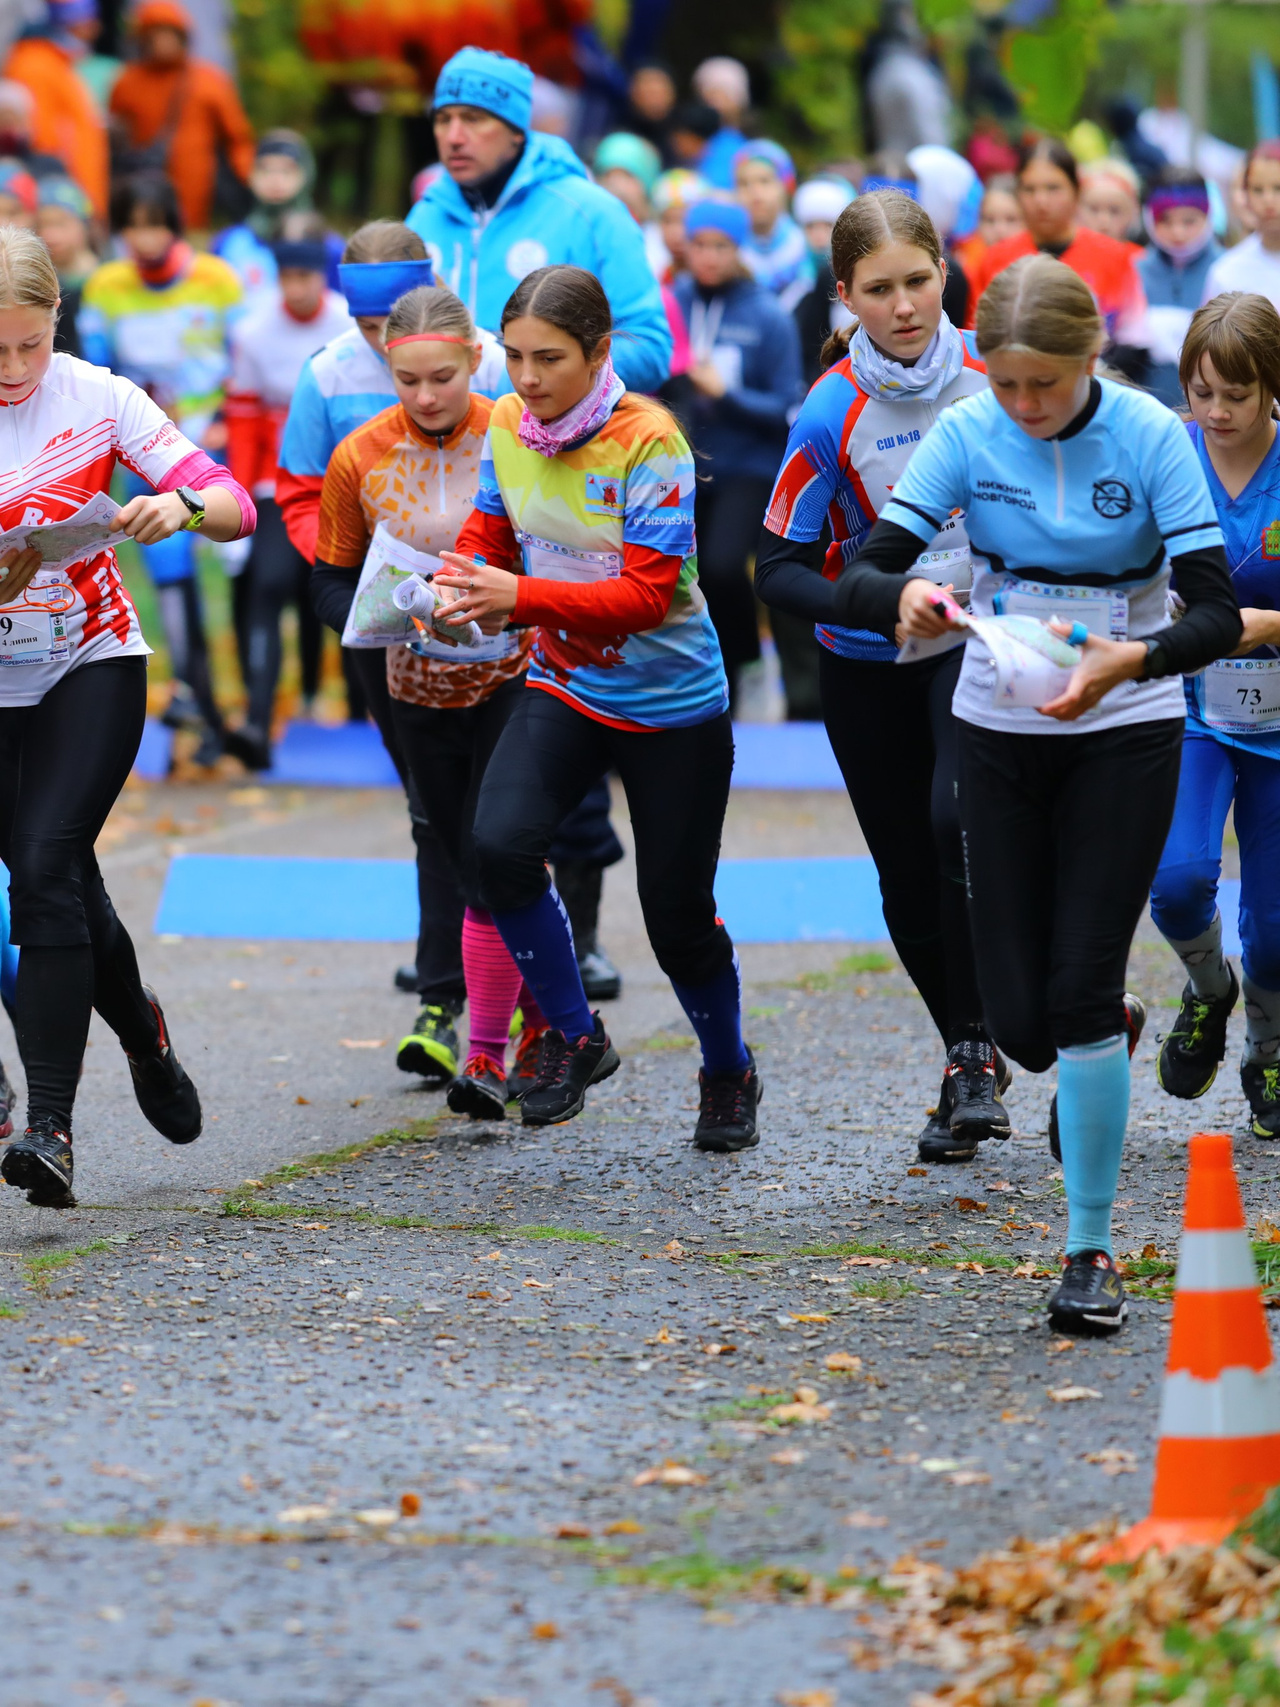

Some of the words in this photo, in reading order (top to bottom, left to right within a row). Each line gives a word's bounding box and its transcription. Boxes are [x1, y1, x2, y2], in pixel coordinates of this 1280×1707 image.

[876, 436, 895, 451] СШ
[896, 429, 921, 446] №18
[977, 480, 1032, 497] НИЖНИЙ
[973, 491, 1037, 511] НОВГОРОД
[2, 639, 7, 647] 4
[9, 636, 38, 646] линия
[1237, 688, 1262, 706] 73
